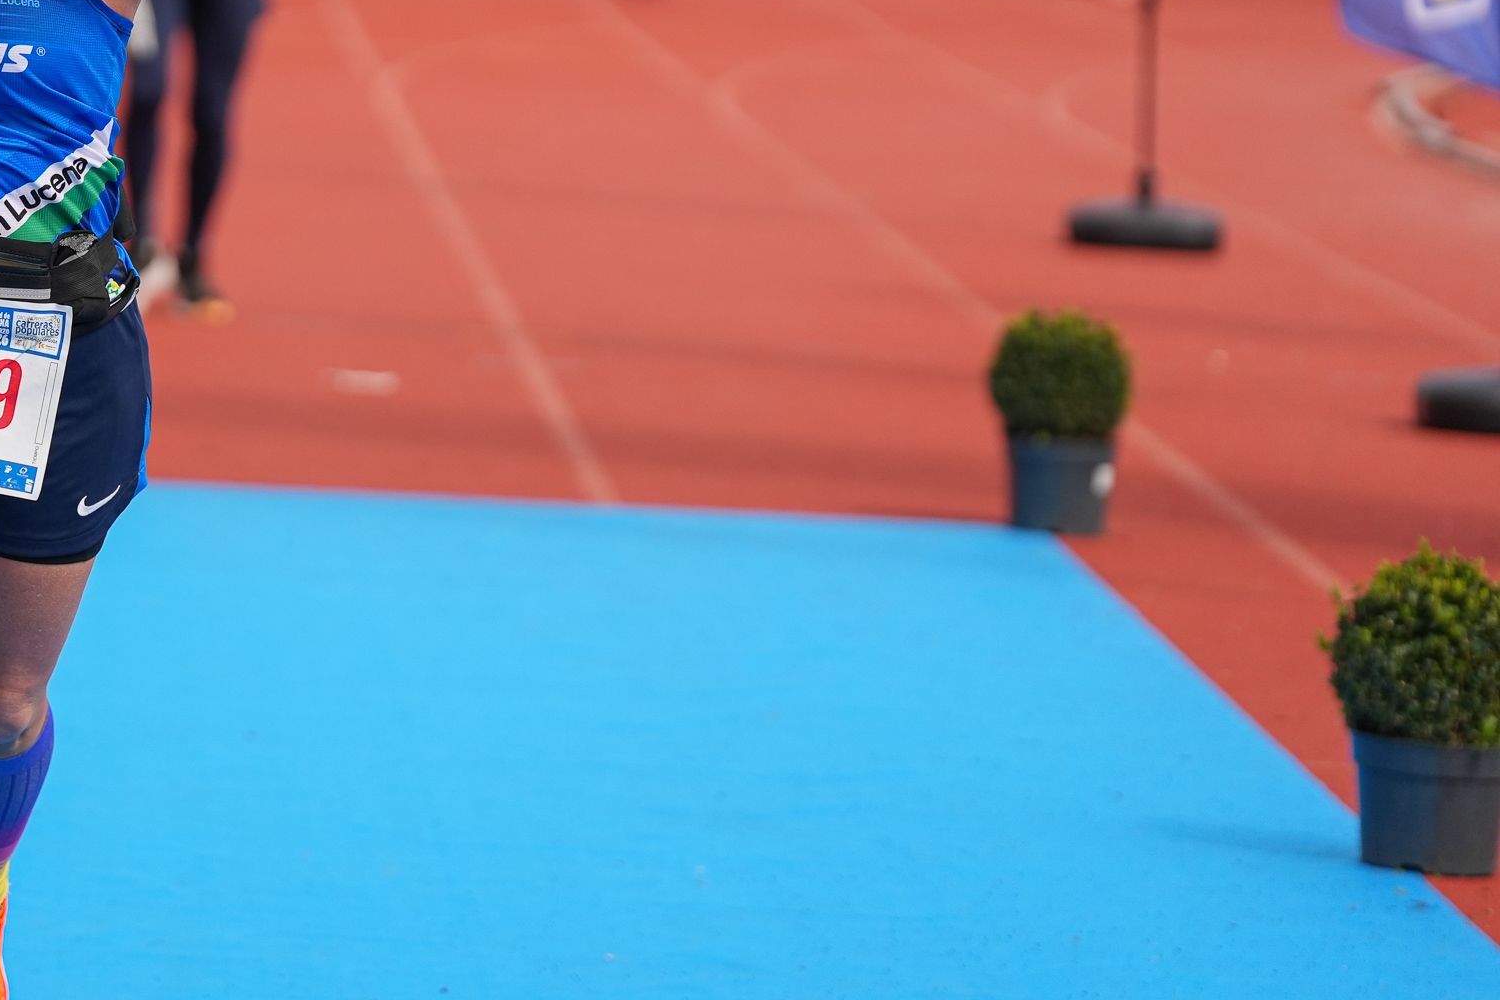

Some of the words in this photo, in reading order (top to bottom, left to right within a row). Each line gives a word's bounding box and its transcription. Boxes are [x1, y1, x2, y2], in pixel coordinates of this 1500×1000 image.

[3, 157, 88, 222] Lucena
[16, 320, 53, 330] carreras
[15, 326, 59, 337] populares
